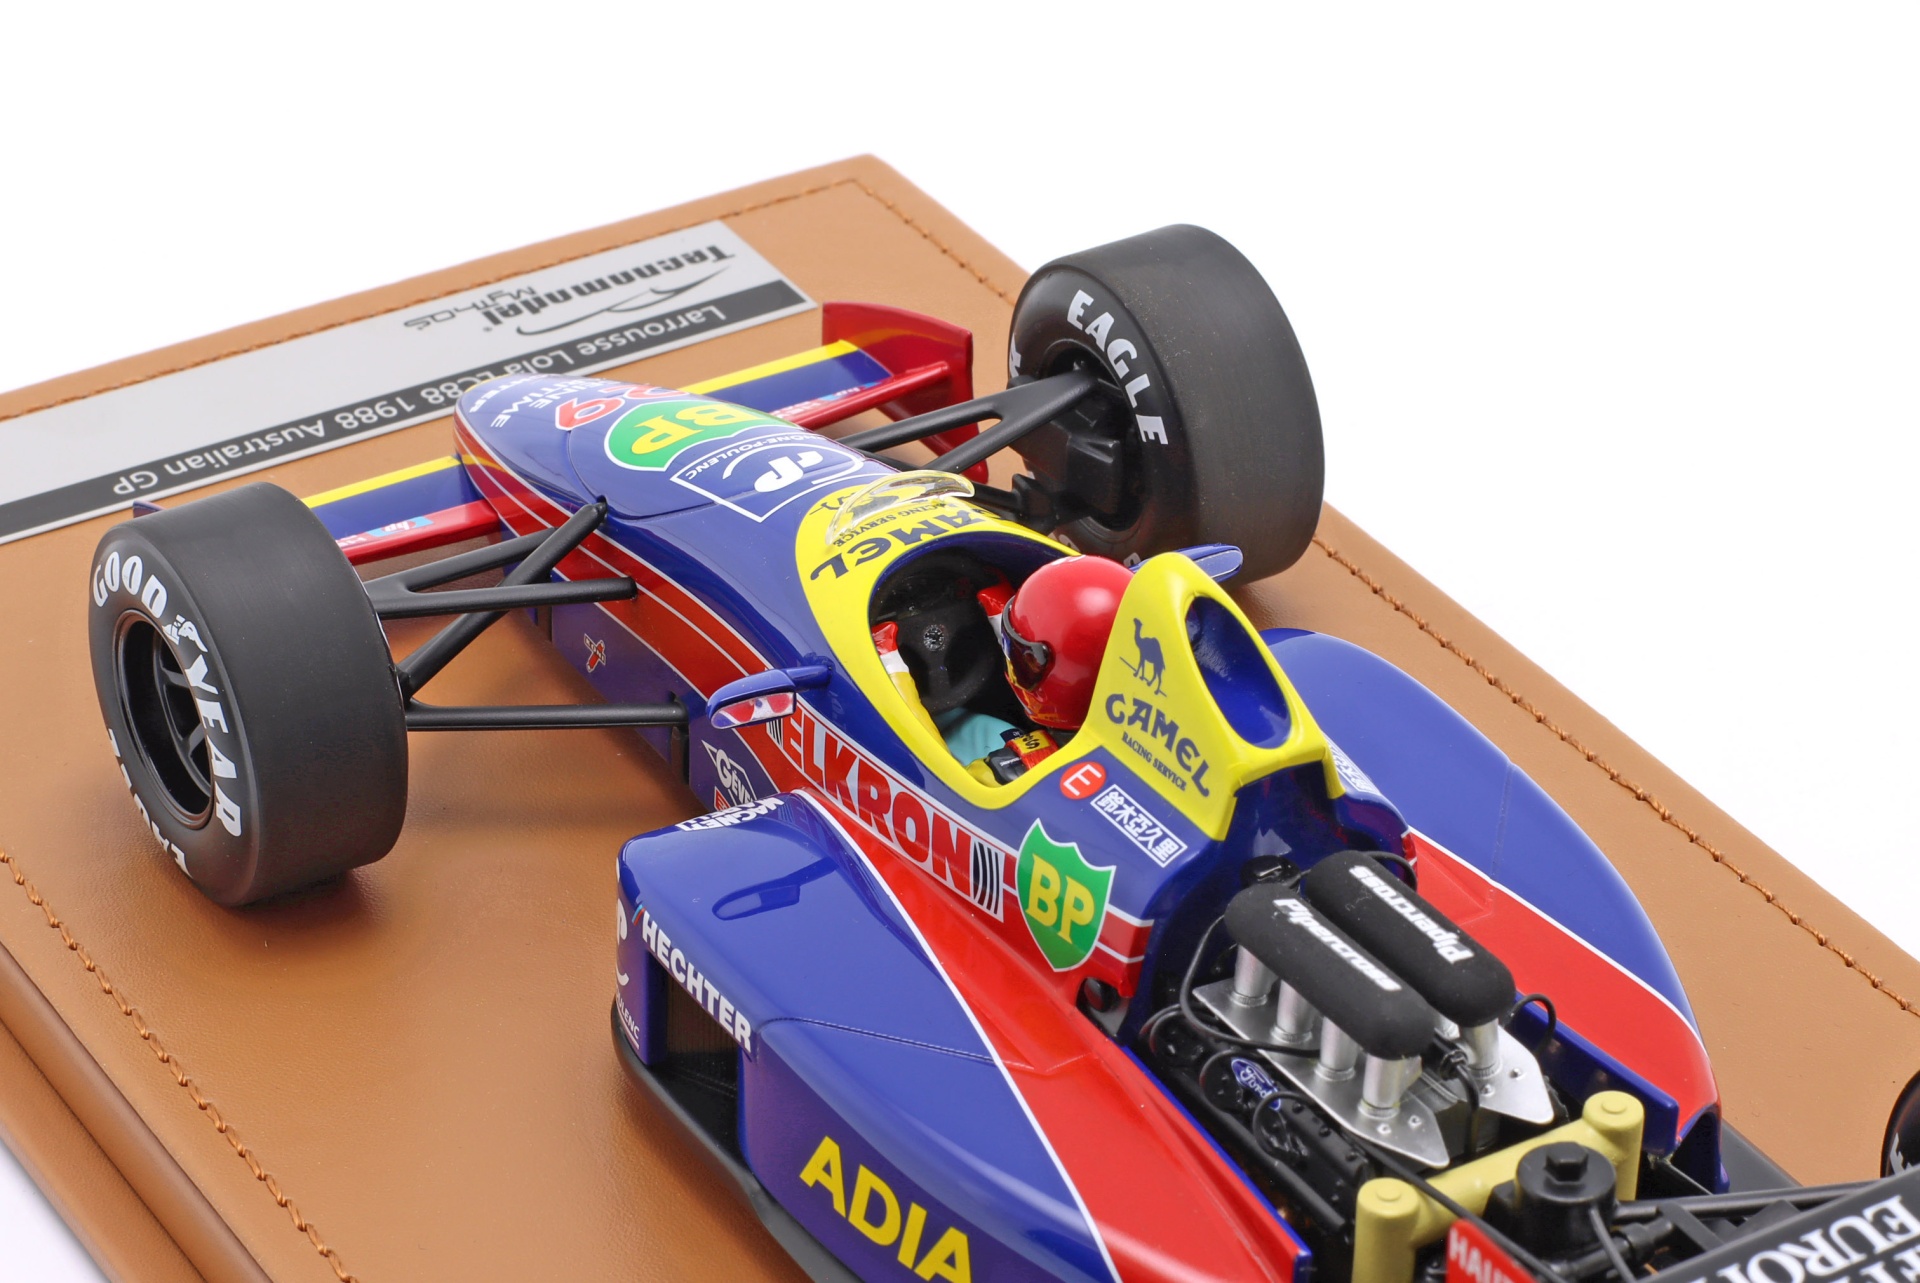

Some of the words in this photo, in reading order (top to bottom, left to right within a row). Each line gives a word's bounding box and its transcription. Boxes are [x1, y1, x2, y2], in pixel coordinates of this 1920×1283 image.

[481, 244, 735, 326] Tecnomodel
[577, 305, 727, 356] Larrousse
[505, 353, 575, 378] Lola
[1067, 290, 1168, 445] EAGLE
[335, 396, 416, 430] 1988
[555, 384, 690, 431] 29
[631, 402, 768, 456] BP
[164, 420, 325, 474] Australian
[113, 472, 158, 496] GP
[1105, 693, 1210, 798] CAMEL
[1121, 731, 1153, 766] RACING
[1152, 758, 1188, 793] SERVICE
[782, 708, 973, 905] ELKRON
[1063, 762, 1102, 797] E
[1026, 853, 1095, 945] BP
[643, 913, 752, 1053] HECHTER
[800, 1136, 973, 1283] ADIA
